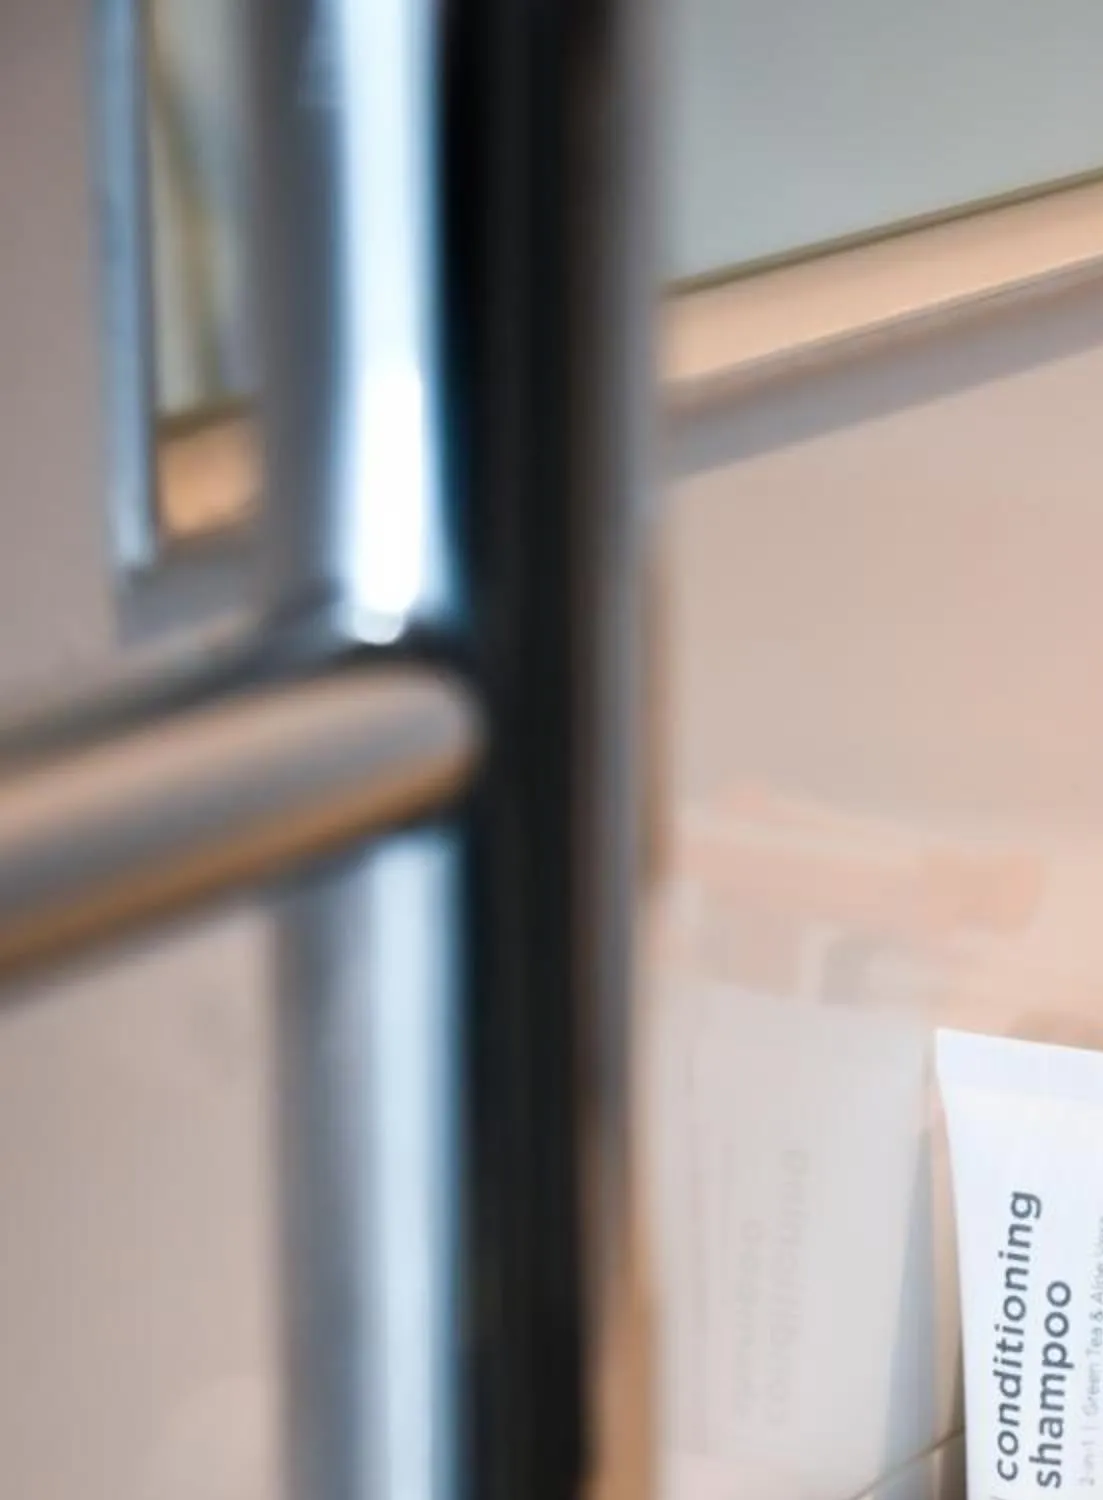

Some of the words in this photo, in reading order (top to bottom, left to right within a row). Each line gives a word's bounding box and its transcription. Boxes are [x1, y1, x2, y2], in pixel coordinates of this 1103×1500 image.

[993, 1190, 1042, 1482] conditioning
[1028, 1281, 1076, 1490] shampoo
[1081, 1362, 1101, 1416] Green
[1085, 1327, 1103, 1355] Tea
